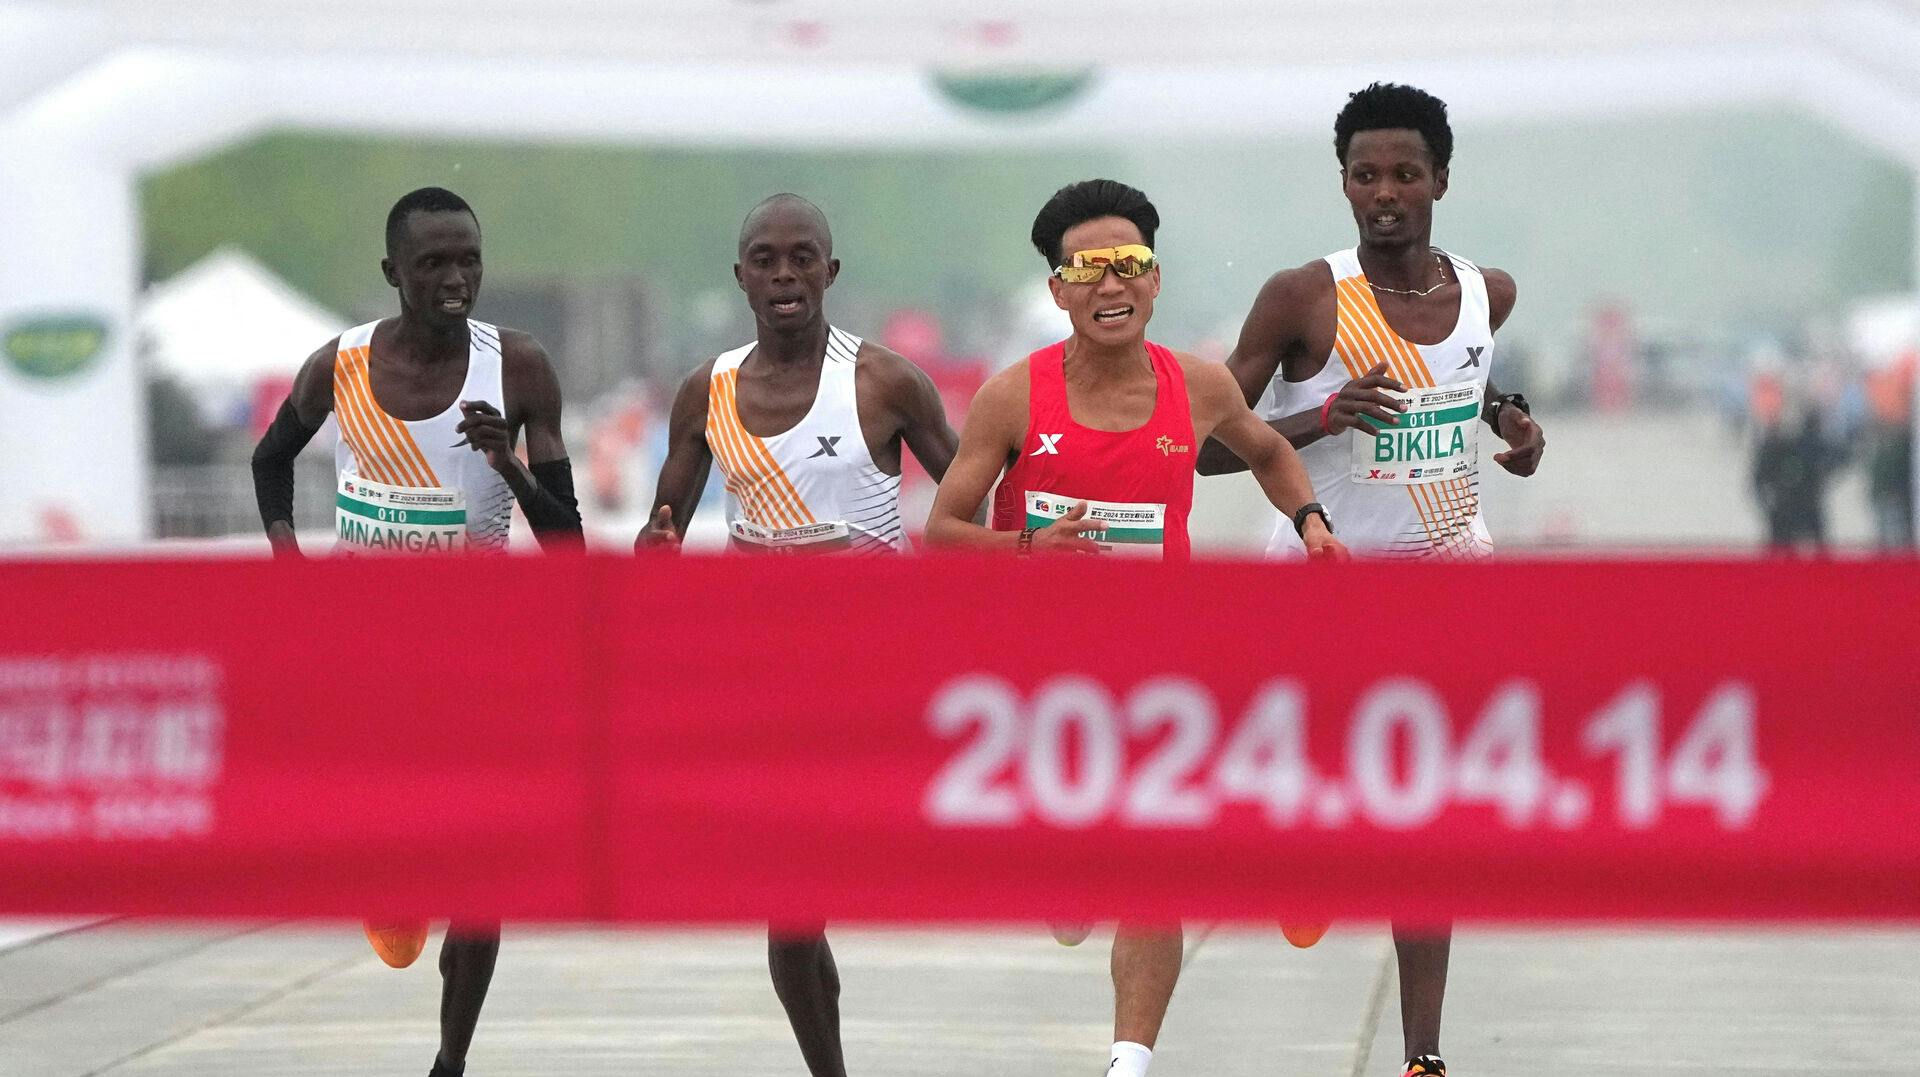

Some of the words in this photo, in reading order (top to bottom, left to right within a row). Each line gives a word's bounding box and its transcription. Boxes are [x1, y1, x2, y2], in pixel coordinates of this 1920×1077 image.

[1410, 412, 1435, 427] 011
[1375, 425, 1464, 462] BIKILA
[378, 508, 407, 523] 010
[341, 516, 458, 553] MNANGAT
[927, 674, 1769, 830] 2024.04.14
